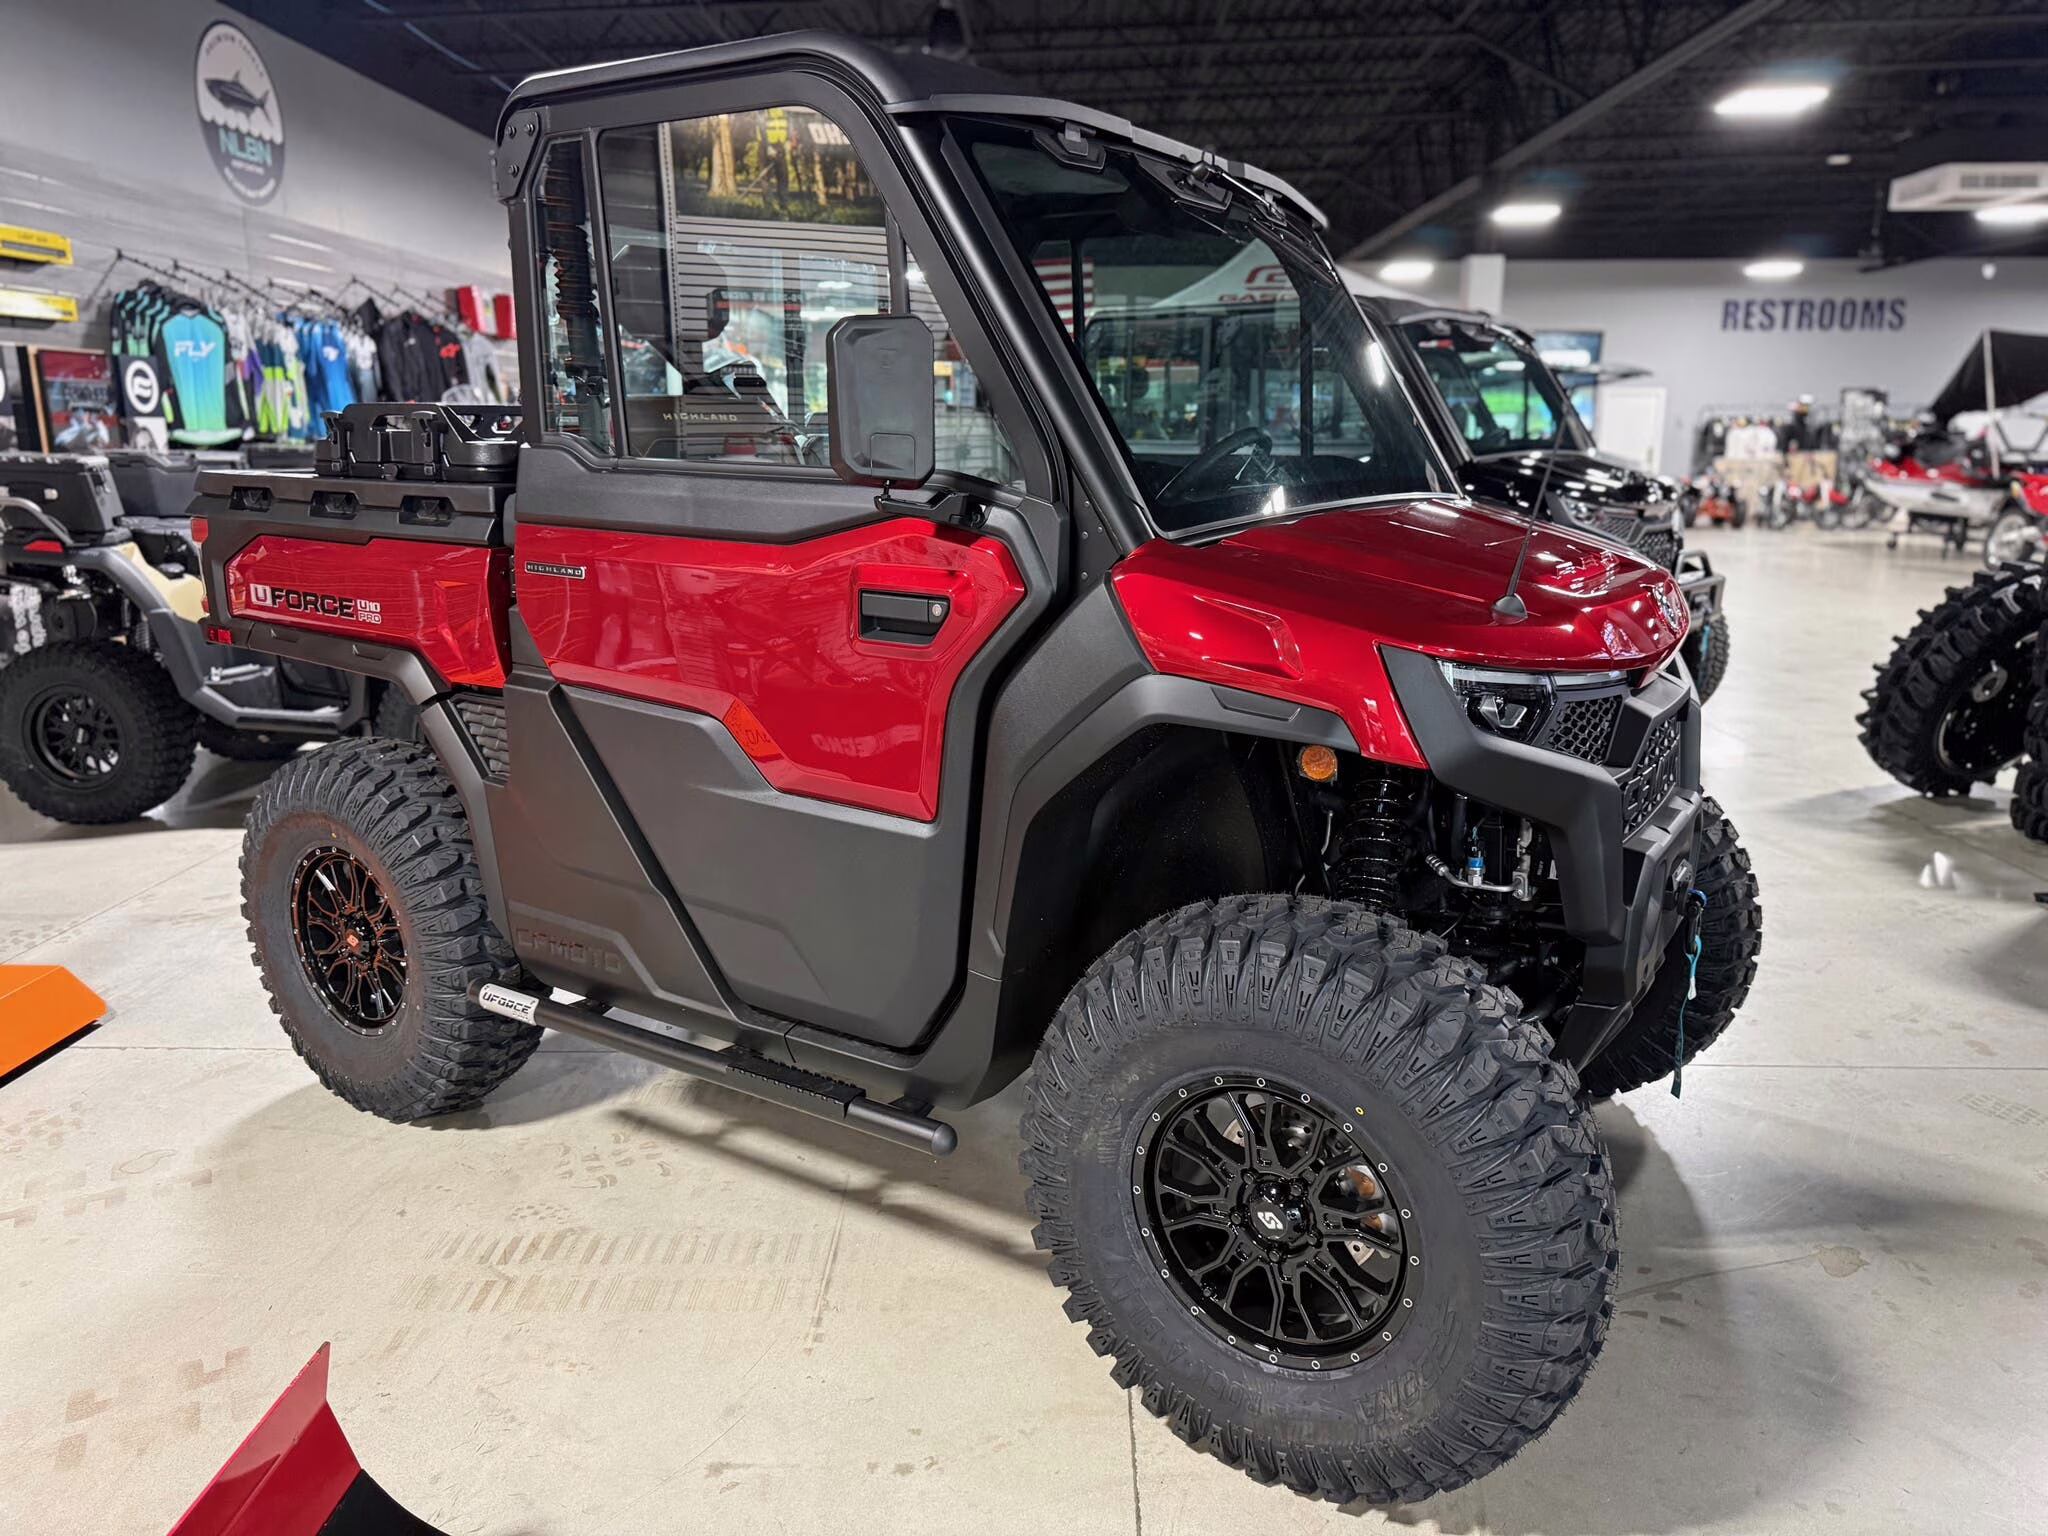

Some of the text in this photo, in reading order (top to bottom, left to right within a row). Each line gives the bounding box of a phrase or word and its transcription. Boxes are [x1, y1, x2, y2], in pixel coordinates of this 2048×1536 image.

[219, 128, 272, 166] NLBN
[1722, 298, 1906, 331] RESTROOMS
[174, 341, 216, 358] FLY
[663, 413, 738, 422] HIGHLAND
[527, 564, 582, 576] HIGHLAND
[250, 583, 381, 620] UFORCE U10
[358, 612, 382, 624] PRO
[482, 991, 532, 1015] UFORCE
